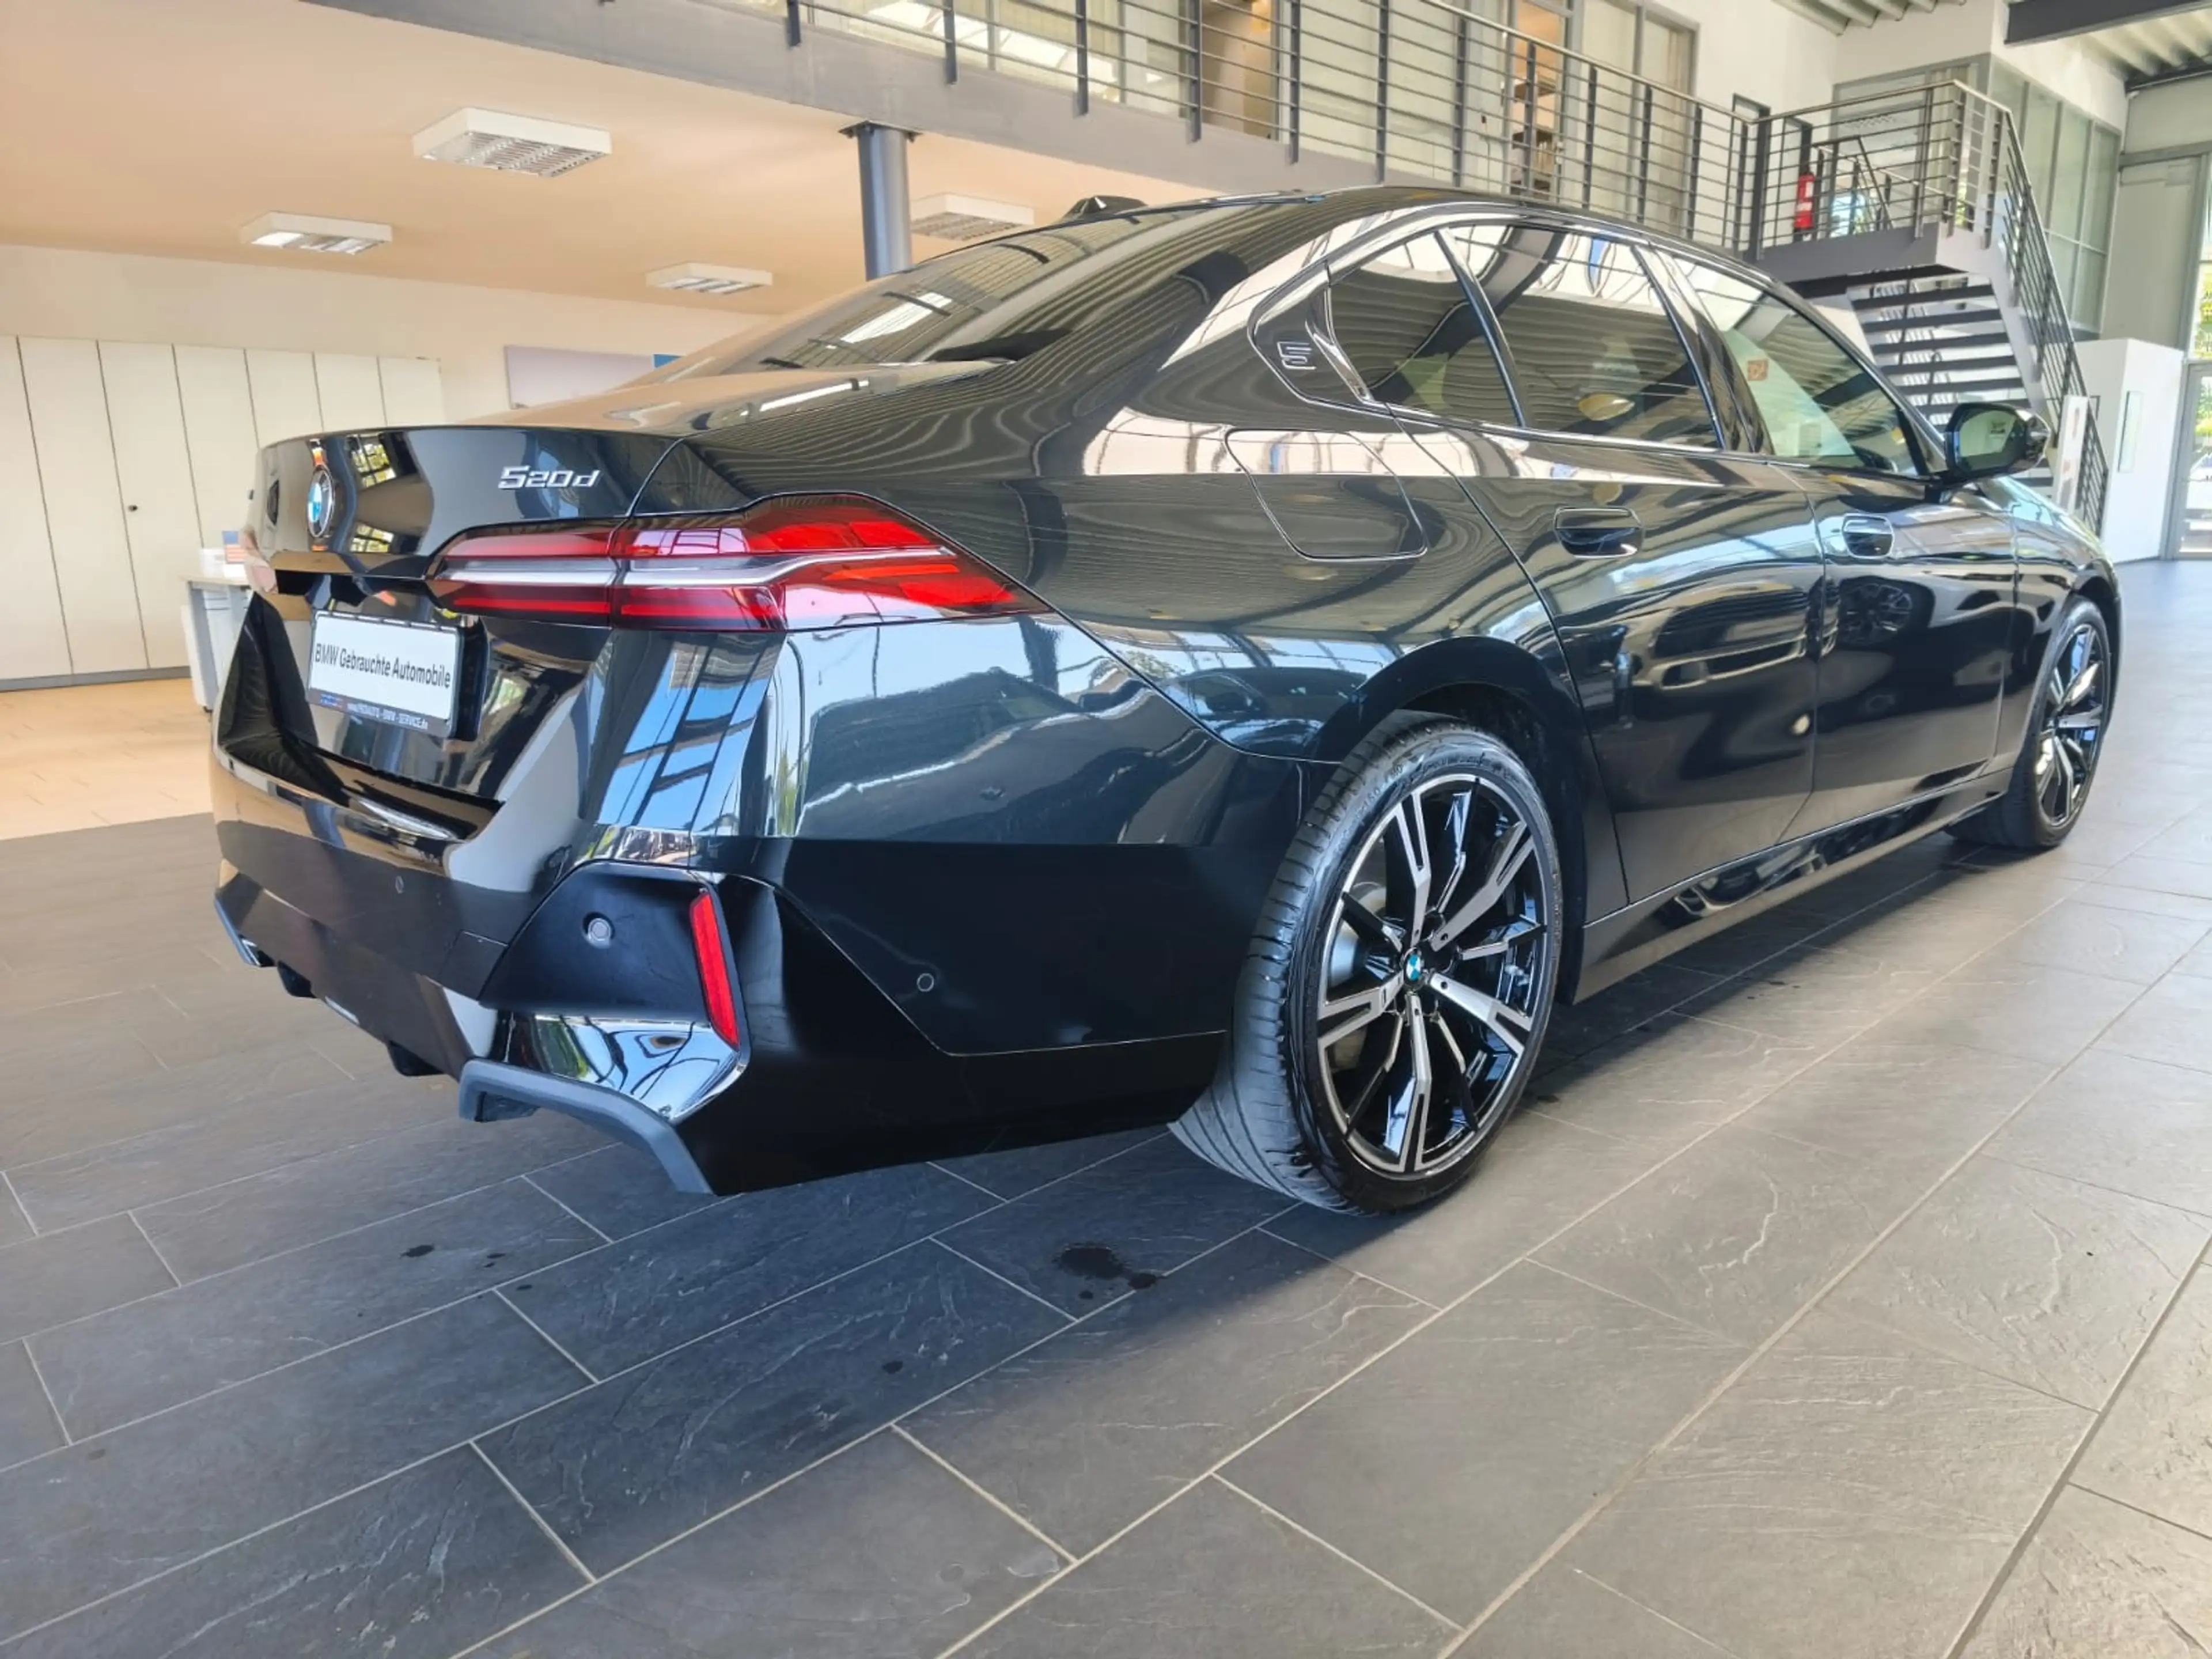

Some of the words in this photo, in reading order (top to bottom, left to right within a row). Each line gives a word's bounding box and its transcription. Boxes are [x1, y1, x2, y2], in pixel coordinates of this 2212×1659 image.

[498, 465, 603, 490] 520d
[315, 643, 339, 665] BMW
[339, 647, 391, 677] Gebrauchte
[392, 657, 450, 689] Automobile
